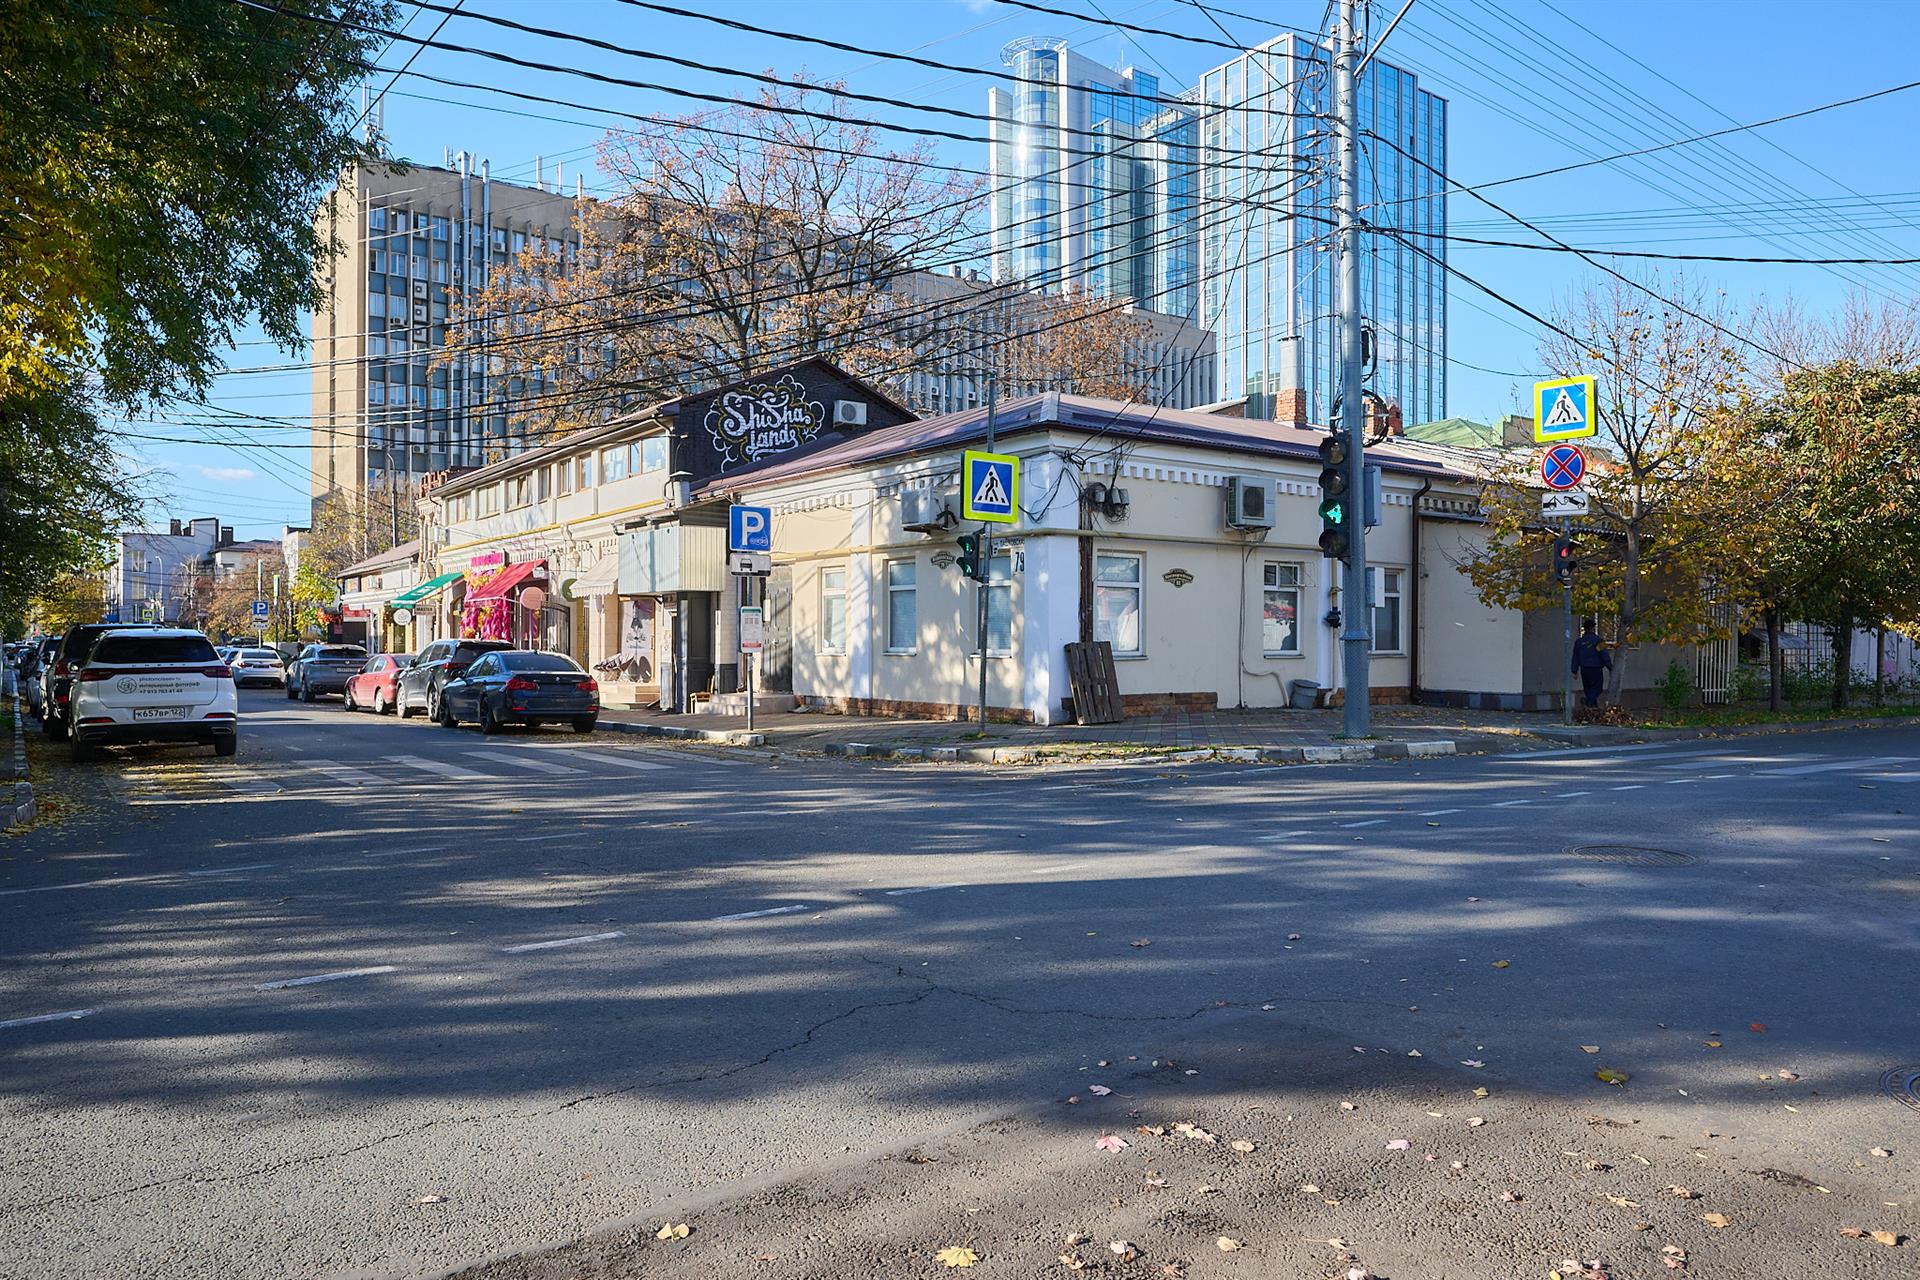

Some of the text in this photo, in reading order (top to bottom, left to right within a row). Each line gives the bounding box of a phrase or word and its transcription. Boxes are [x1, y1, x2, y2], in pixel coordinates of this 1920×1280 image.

[723, 391, 811, 436] ShiSha
[741, 510, 765, 546] P
[1015, 551, 1025, 572] 79
[257, 602, 266, 614] P
